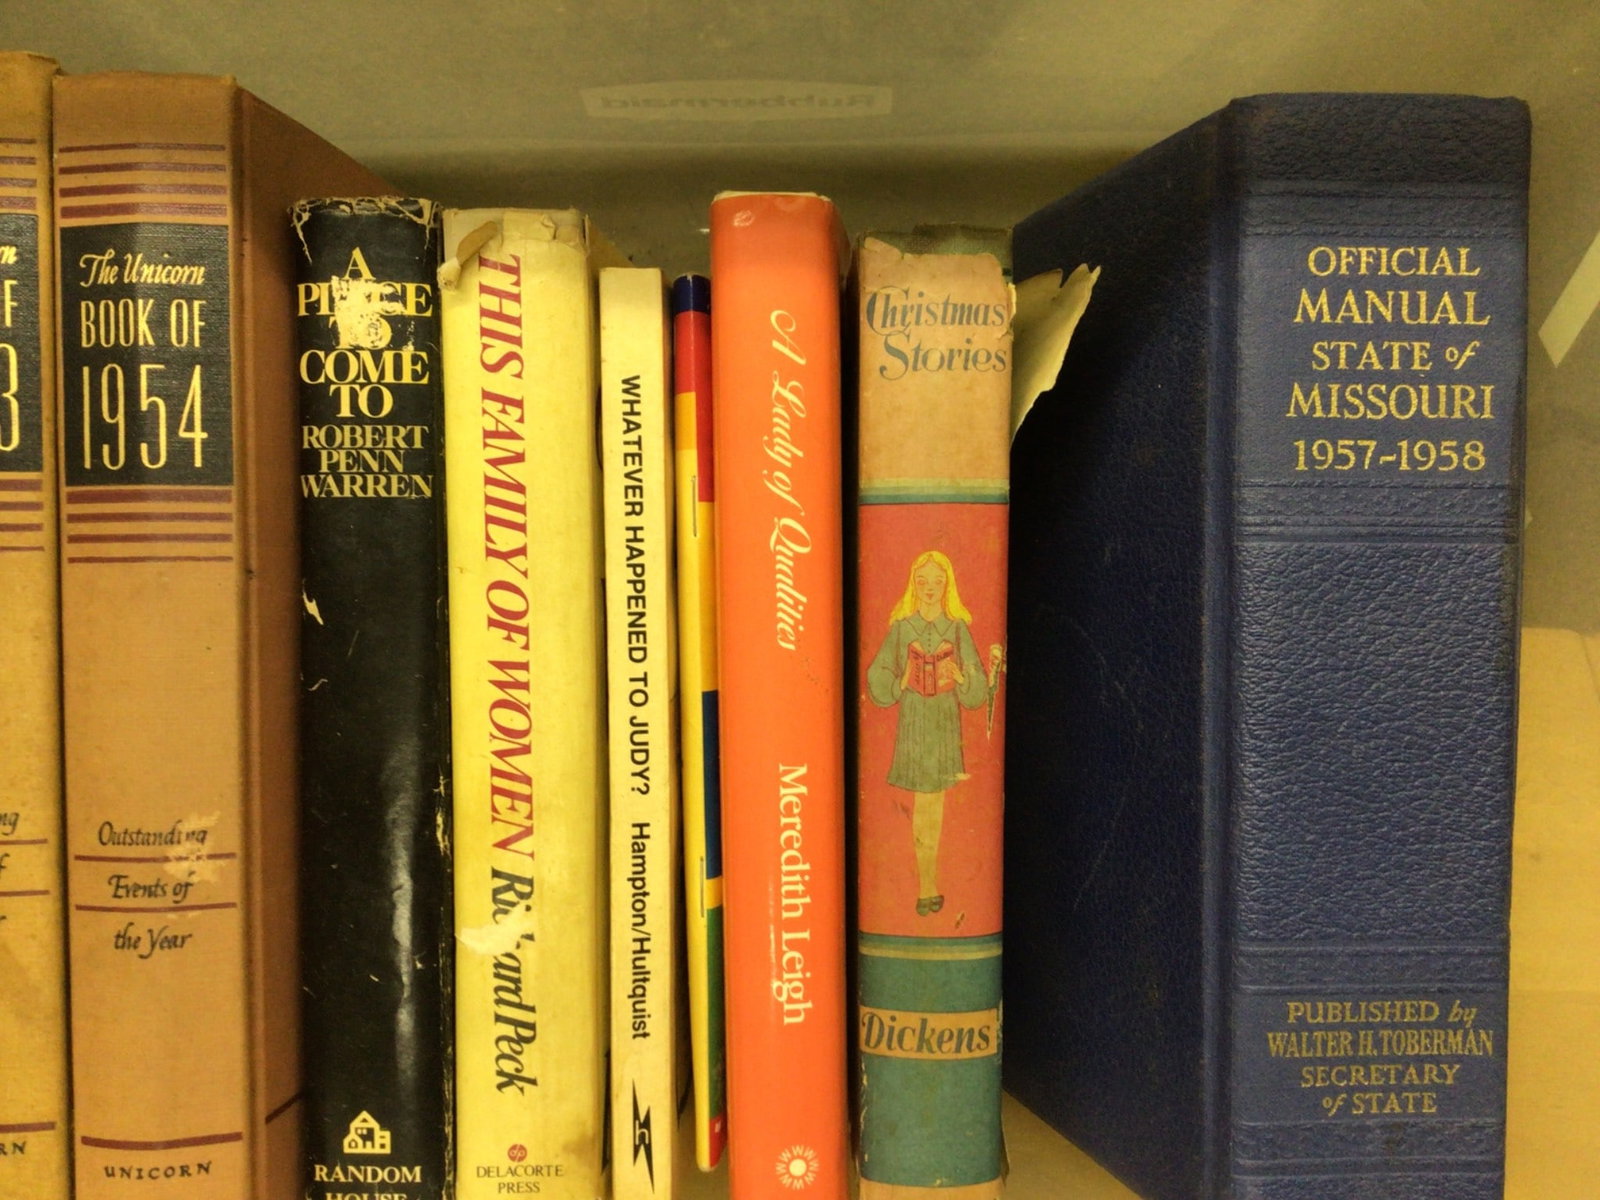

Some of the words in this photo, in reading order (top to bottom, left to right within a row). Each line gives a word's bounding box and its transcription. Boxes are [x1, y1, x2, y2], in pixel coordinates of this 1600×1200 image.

[79, 248, 118, 288] The
[123, 252, 206, 286] Unicorn
[344, 246, 376, 281] A
[1307, 246, 1481, 277] OFFICIAL
[80, 298, 155, 348] BOOK
[169, 298, 207, 348] OF
[479, 251, 525, 379] THIS
[866, 285, 1006, 336] Christmas
[1293, 287, 1491, 325] MANUAL
[769, 309, 807, 365] A
[879, 331, 1007, 381] Stories
[1311, 341, 1433, 371] STATE
[1445, 341, 1481, 370] of
[300, 350, 430, 385] COME
[82, 363, 209, 470] 1954
[329, 384, 393, 419] TO
[762, 369, 808, 468] Lady
[1286, 382, 1496, 420] MISSOURI
[302, 424, 430, 449] ROBERT
[621, 374, 644, 517] WHATEVER
[1293, 439, 1487, 472] 1957-1958
[318, 449, 405, 473] PENN
[301, 474, 434, 499] WARREN
[481, 387, 529, 579] FAMILY
[762, 469, 806, 517] of
[625, 525, 648, 664] HAPPENED
[769, 517, 813, 652] Qualities
[486, 580, 530, 652] OF
[628, 671, 648, 708] TO
[487, 658, 536, 861] WOMEN
[630, 715, 651, 797] JUDY?
[778, 763, 812, 921] Meredith
[108, 873, 169, 899] Events
[172, 870, 197, 904] of
[114, 921, 143, 950] the
[137, 924, 193, 960] Year
[627, 821, 651, 1041] Hampton/Hultquist
[771, 929, 814, 1027] Leigh
[861, 1011, 991, 1055] Dickens
[1286, 1000, 1440, 1024] PUBLISHED
[1447, 1000, 1478, 1027] by
[493, 1012, 538, 1096] Peck
[1267, 1031, 1353, 1058] WALTER
[1379, 1029, 1494, 1056] TOBERMAN
[1301, 1063, 1461, 1088] SECRETARY
[1321, 1093, 1348, 1117] of
[1352, 1091, 1438, 1115] STATE
[104, 1160, 213, 1180] UNICORN
[314, 1164, 422, 1183] RANDOM
[476, 1164, 564, 1178] DELACORTE
[497, 1181, 541, 1194] PRESS
